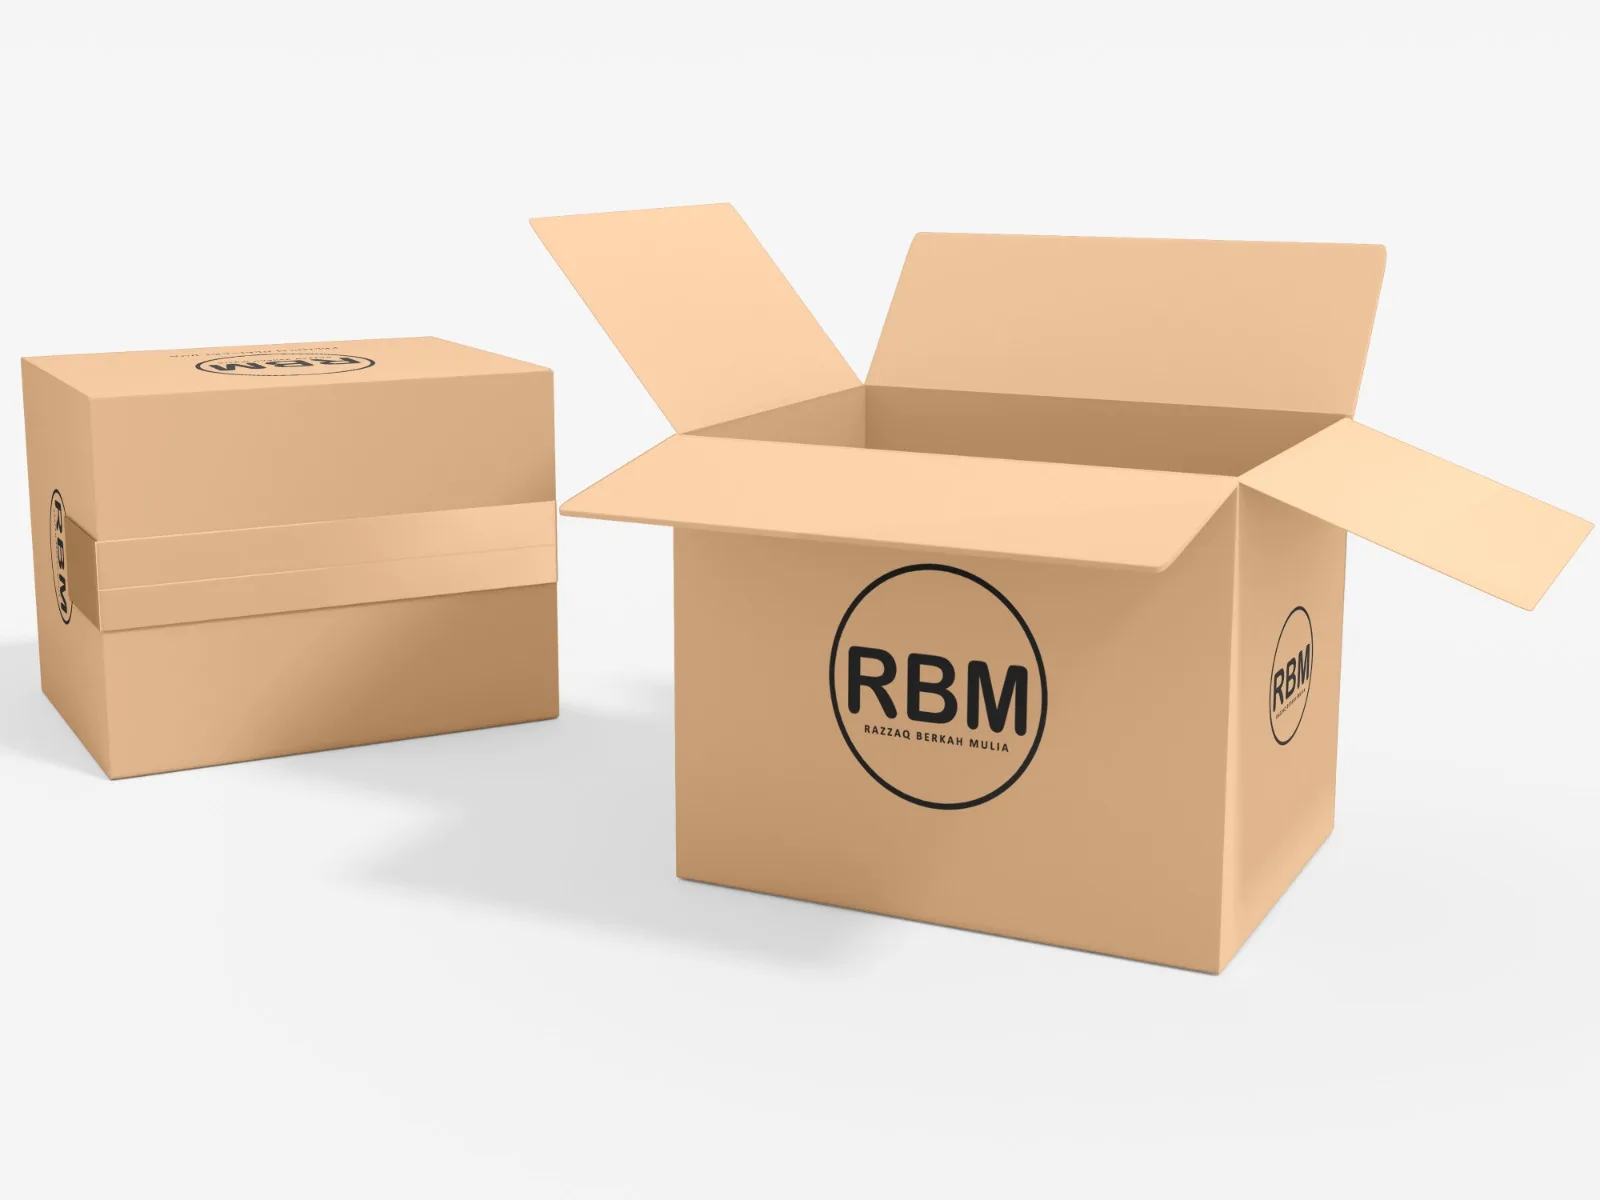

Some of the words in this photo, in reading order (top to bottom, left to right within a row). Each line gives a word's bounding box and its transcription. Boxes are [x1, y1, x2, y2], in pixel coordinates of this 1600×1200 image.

[209, 357, 361, 371] RBM
[54, 500, 67, 614] RBM
[848, 646, 1028, 736] RBM
[1272, 643, 1311, 712] RBM
[864, 724, 911, 739] RAZZAQ
[916, 731, 963, 746] BERKAH
[969, 738, 1009, 753] MULIA
